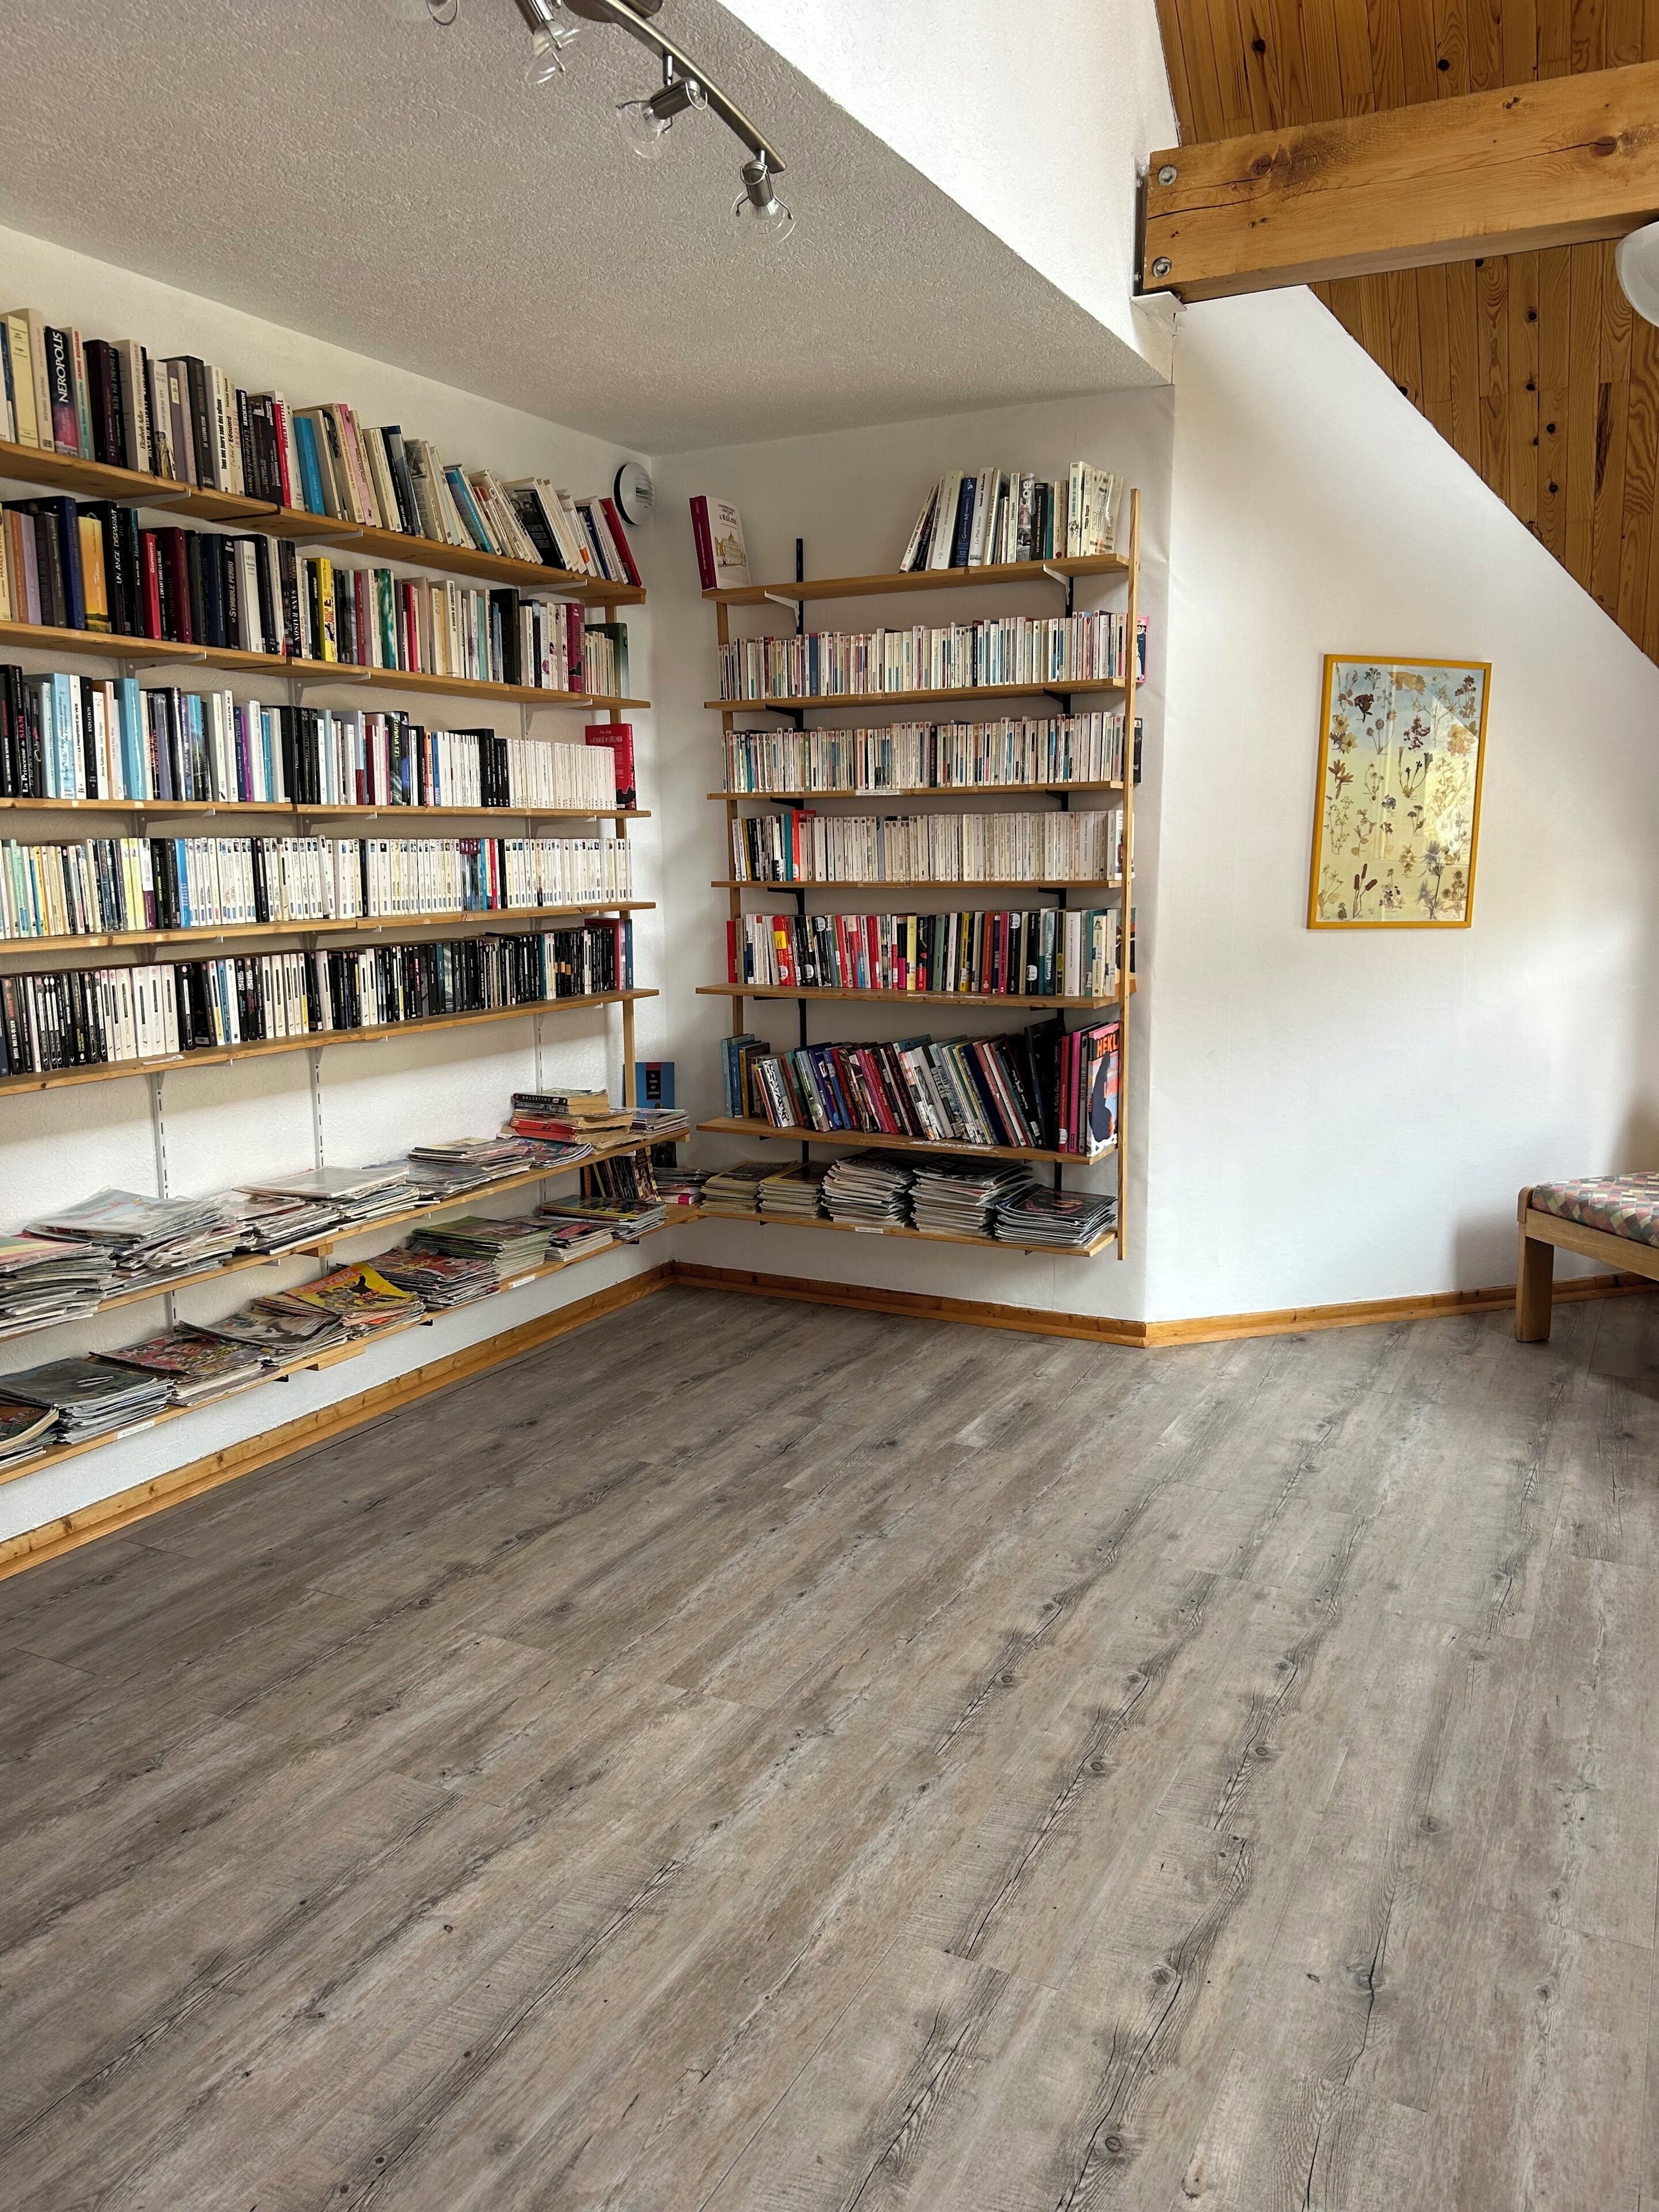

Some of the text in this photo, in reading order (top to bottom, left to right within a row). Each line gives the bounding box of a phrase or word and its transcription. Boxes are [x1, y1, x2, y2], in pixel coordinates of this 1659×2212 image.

[52, 331, 69, 403] NEROPOLIS
[112, 384, 118, 393] EN
[138, 425, 146, 449] Elizabeth
[219, 435, 228, 449] jours
[719, 513, 737, 525] L'ÉGLISE
[910, 531, 919, 548] MEDECINE
[116, 573, 122, 584] UN
[293, 612, 301, 641] RAISON
[22, 783, 28, 793] La
[1097, 1033, 1119, 1058] HEKL
